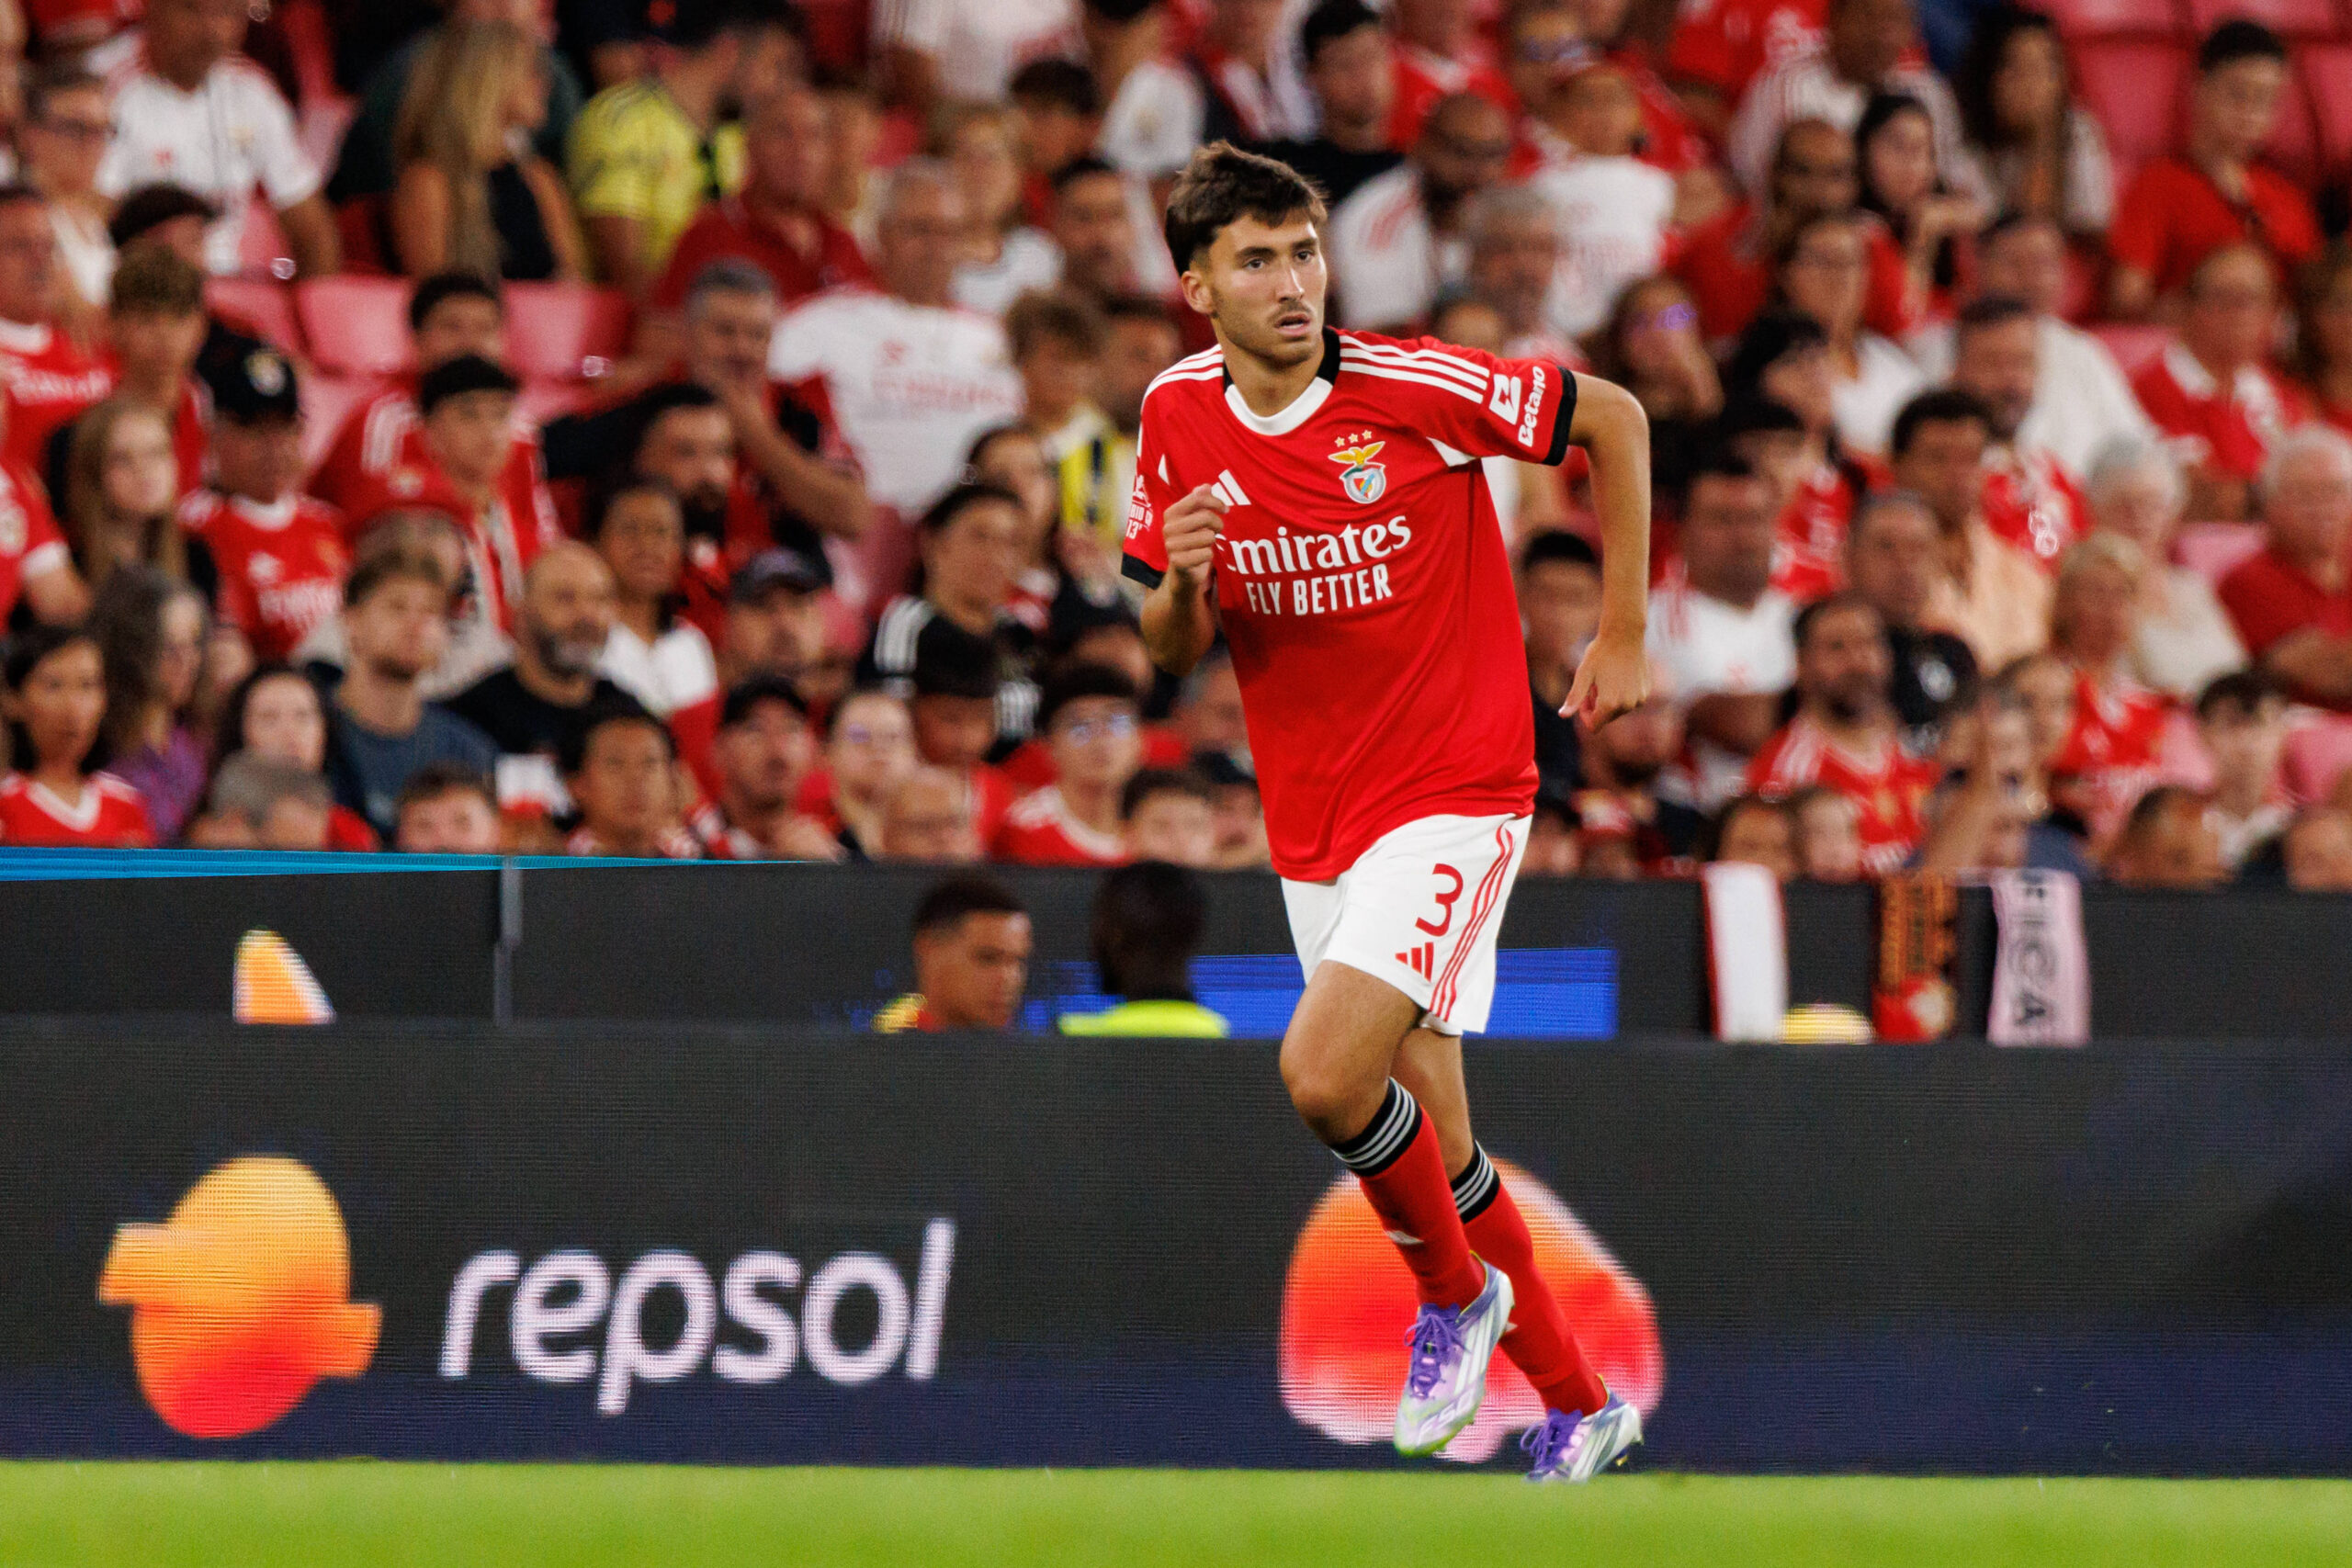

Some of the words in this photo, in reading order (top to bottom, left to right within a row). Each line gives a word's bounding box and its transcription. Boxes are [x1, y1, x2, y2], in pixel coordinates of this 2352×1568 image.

[1518, 366, 1545, 447] Betano
[1245, 581, 1282, 615] FLY
[1293, 563, 1393, 616] BETTER
[1415, 863, 1464, 937] 3
[437, 1217, 956, 1416] repsol
